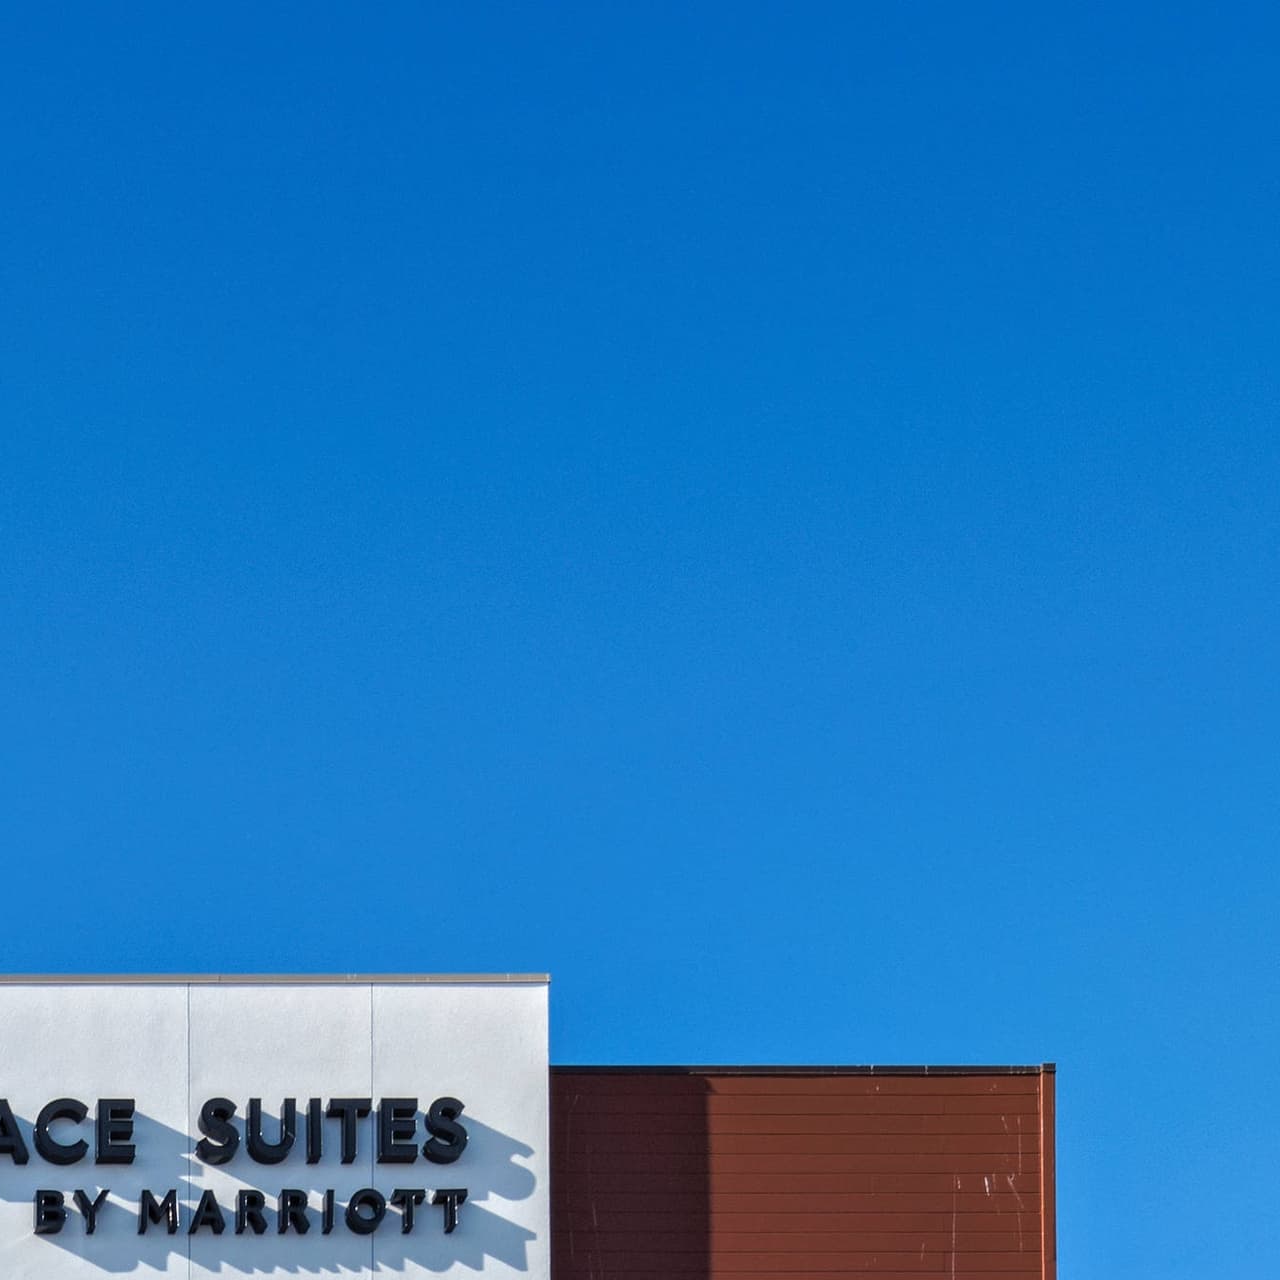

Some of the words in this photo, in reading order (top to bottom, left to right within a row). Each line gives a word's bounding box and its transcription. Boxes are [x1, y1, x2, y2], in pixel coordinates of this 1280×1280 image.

[194, 1096, 470, 1165] SUITES
[33, 1188, 111, 1236] BY
[136, 1188, 469, 1236] MARRIOTT
